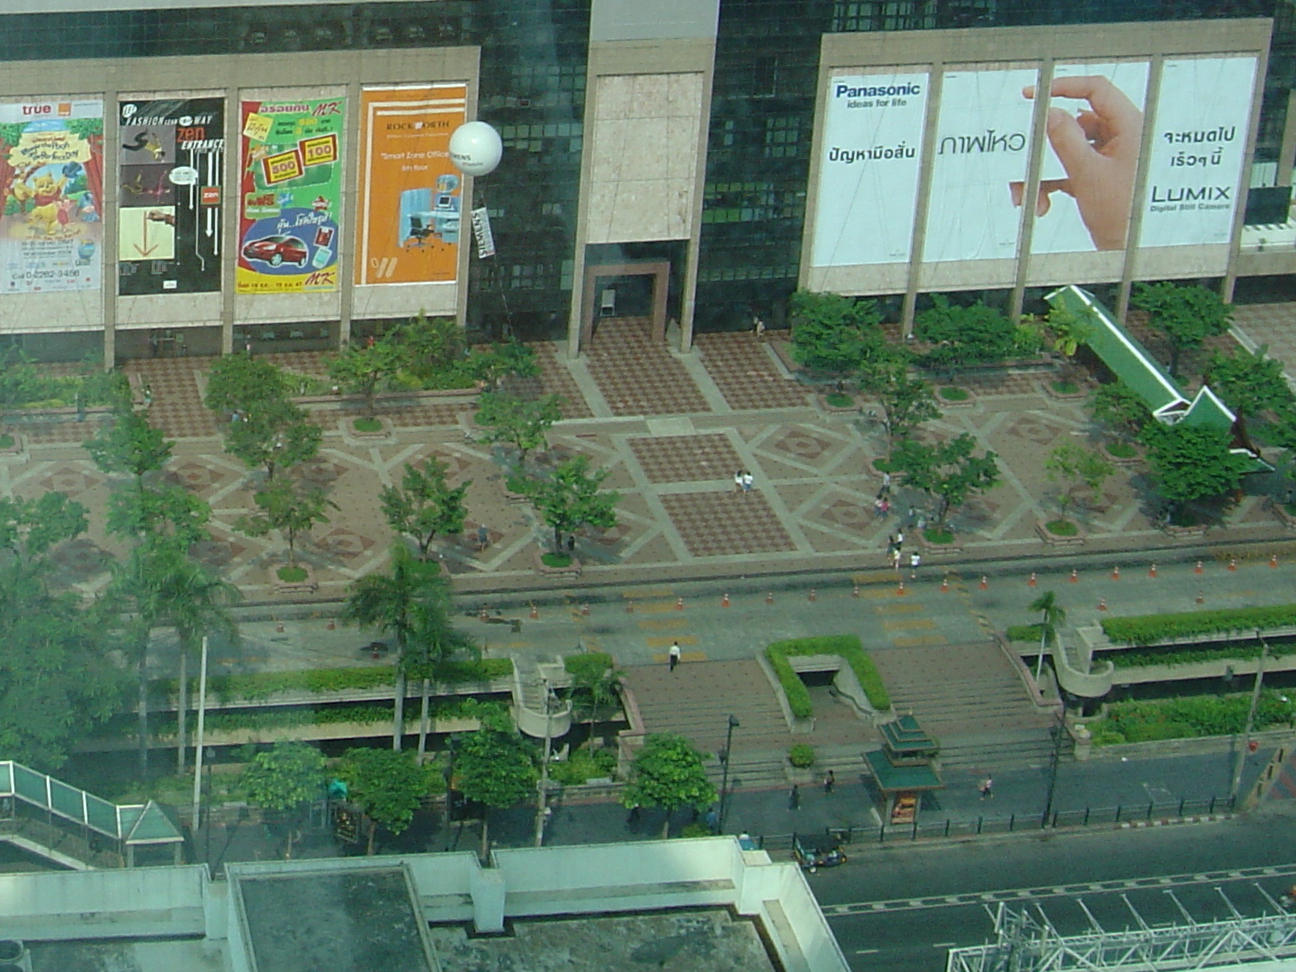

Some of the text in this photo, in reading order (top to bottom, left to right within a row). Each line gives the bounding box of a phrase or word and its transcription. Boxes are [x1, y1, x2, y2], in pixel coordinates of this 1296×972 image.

[836, 82, 921, 98] Panasonic
[22, 105, 52, 115] true
[312, 101, 343, 117] MK
[876, 100, 889, 108] for
[891, 99, 907, 107] life
[125, 116, 164, 126] FASHION
[194, 115, 213, 125] WAY
[176, 126, 205, 142] zen
[938, 129, 1026, 155] ภาพไหว
[1164, 126, 1236, 144] จะหมดไป
[181, 138, 224, 150] ENTRANCE
[308, 144, 332, 158] 100
[1151, 186, 1231, 203] LUMIX
[1150, 204, 1177, 213] Digital
[1198, 203, 1231, 211] Camera
[471, 212, 488, 259] SIEMENS
